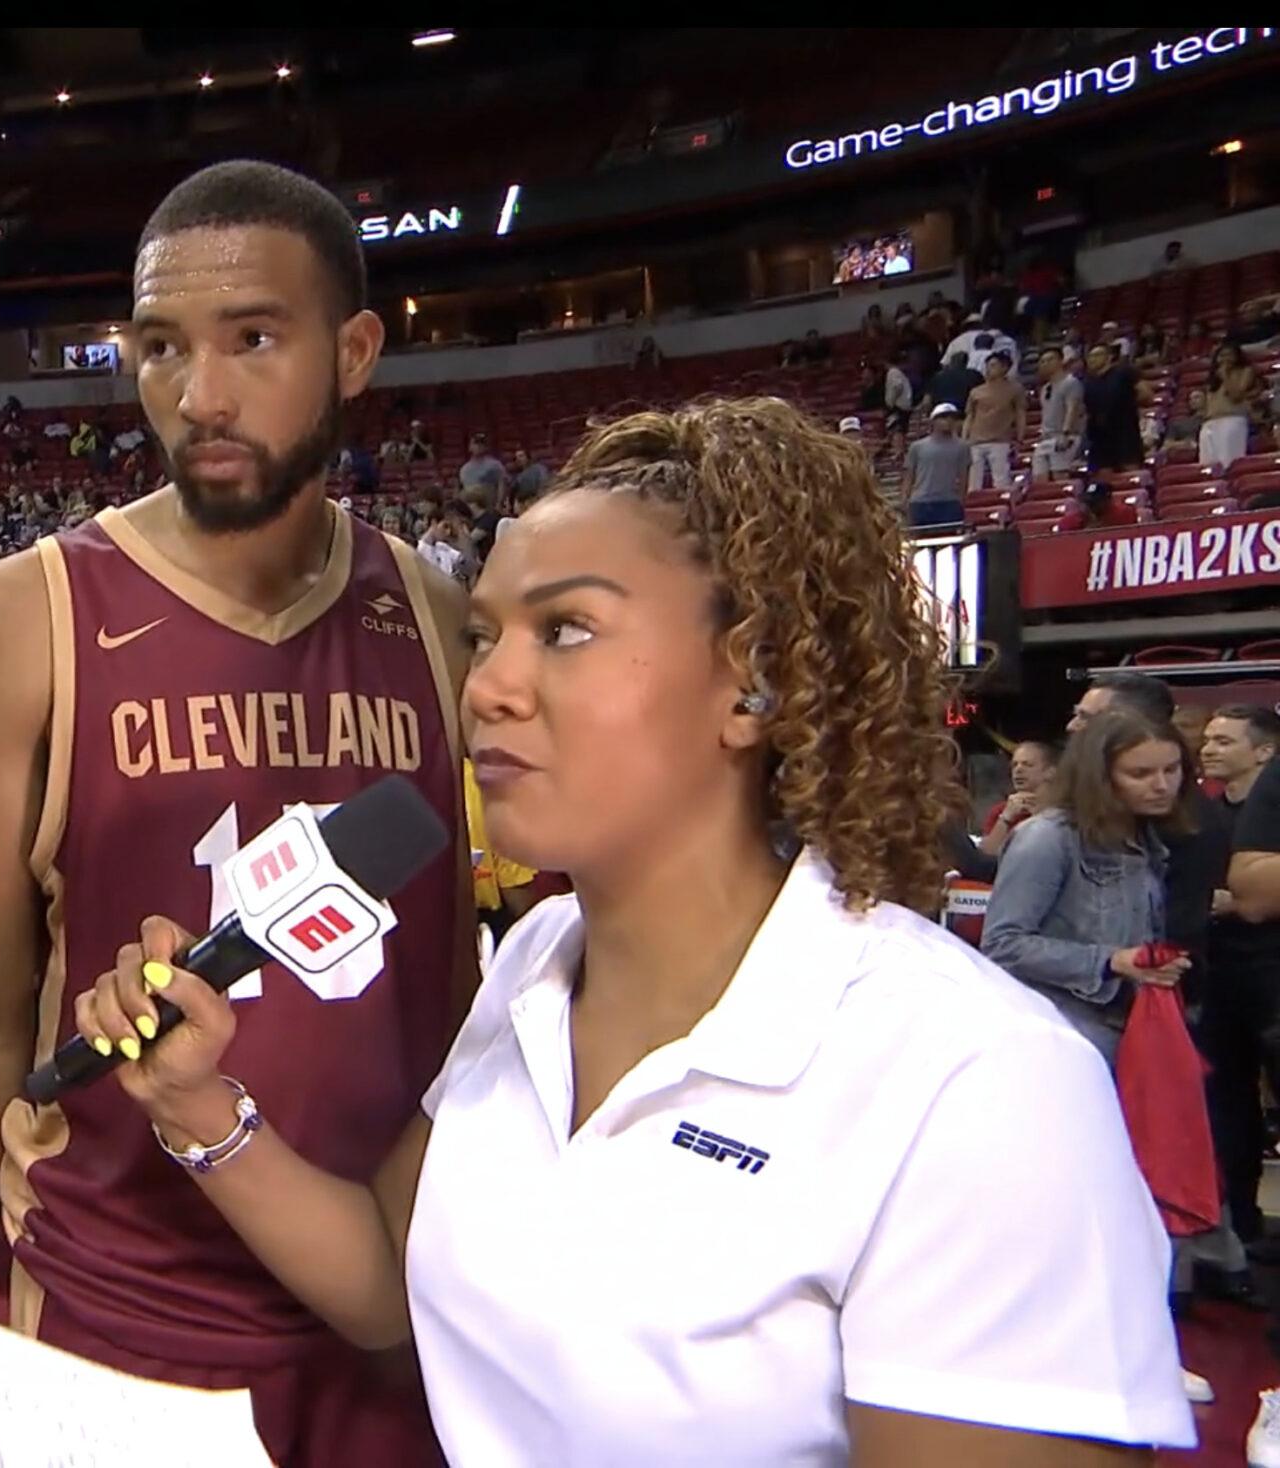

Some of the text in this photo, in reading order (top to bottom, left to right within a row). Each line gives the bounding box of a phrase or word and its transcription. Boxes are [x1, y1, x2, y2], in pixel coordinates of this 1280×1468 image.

[785, 55, 1137, 168] Game-changing
[361, 616, 418, 640] CLIFFS
[111, 691, 421, 779] CLEVELAND
[672, 1120, 771, 1175] ESPN
